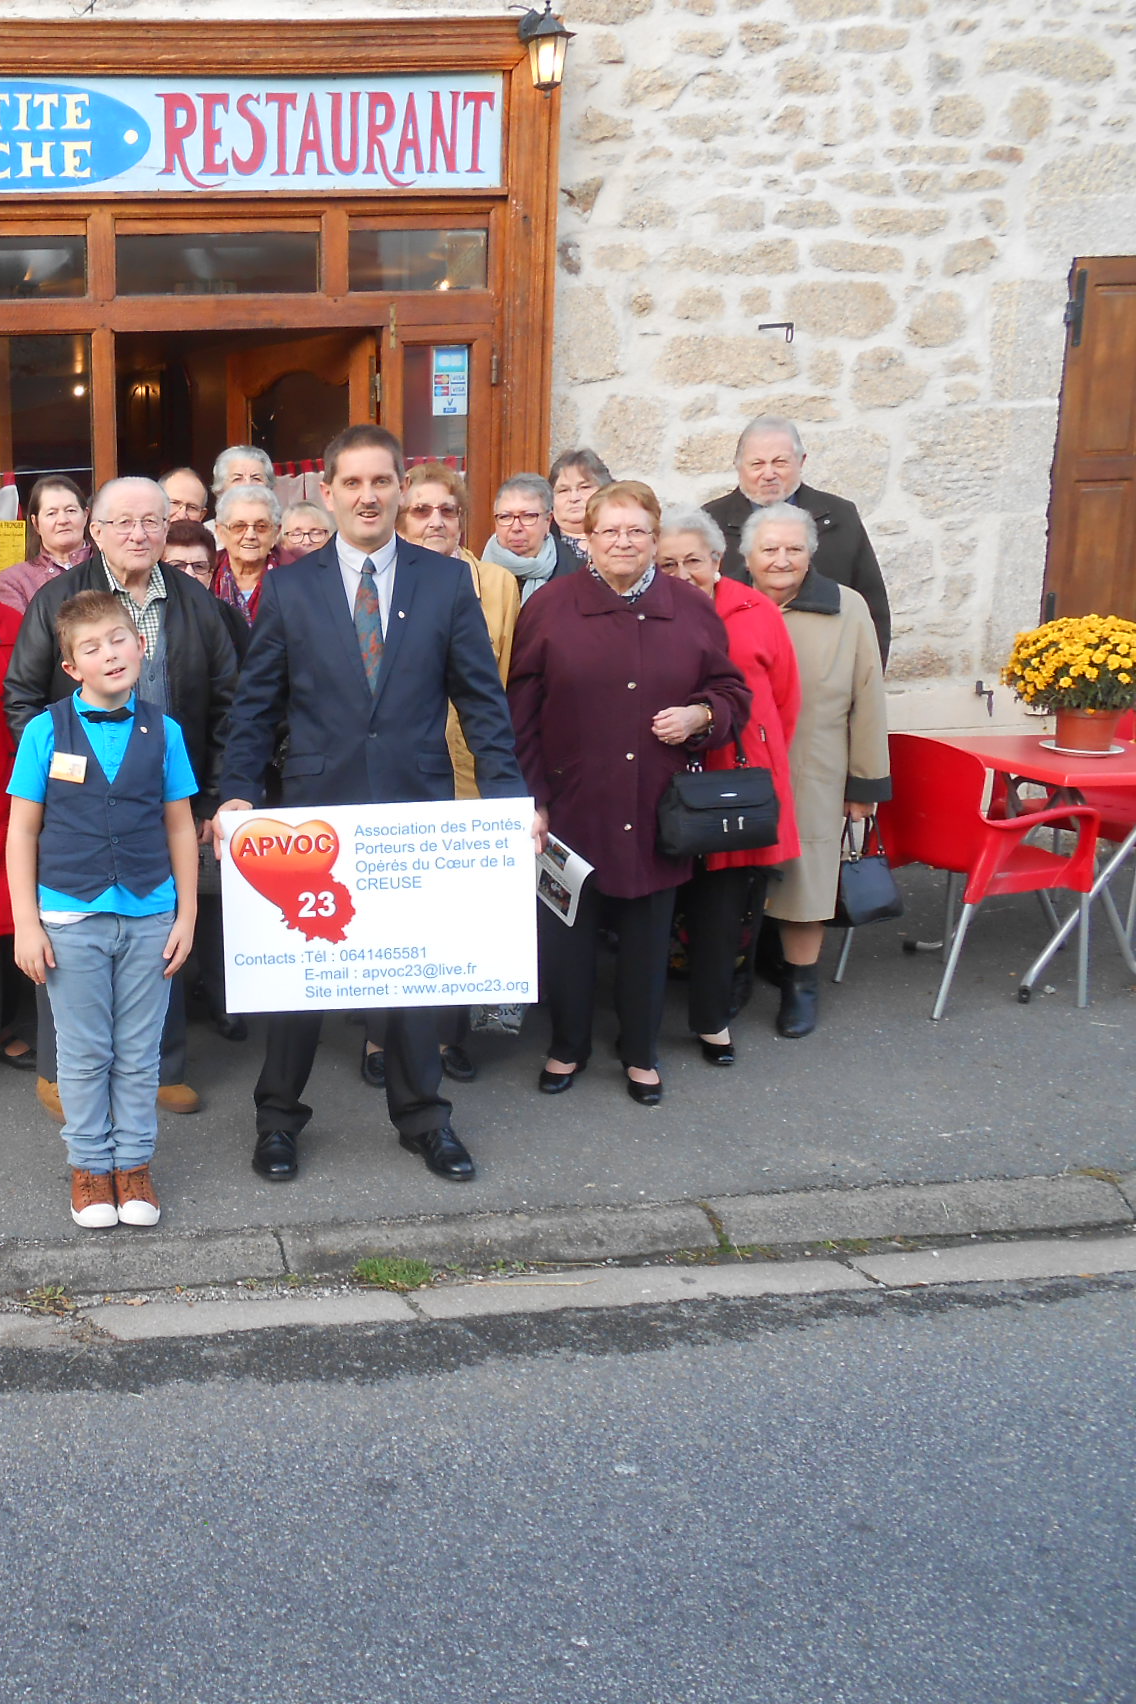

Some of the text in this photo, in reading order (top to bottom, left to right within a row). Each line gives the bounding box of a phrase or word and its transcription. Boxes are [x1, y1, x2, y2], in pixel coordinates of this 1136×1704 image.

[155, 90, 496, 189] RESTAURANT
[354, 818, 525, 837] Association des Pontés,
[239, 833, 335, 857] APVOC
[355, 837, 509, 855] Porteurs de Valves et
[355, 854, 515, 875] Opérés du Cœur de la
[356, 875, 422, 891] CREUSE
[297, 890, 337, 918] 23
[234, 953, 296, 966] Contacts
[339, 947, 427, 962] 0641465581
[305, 967, 349, 981] E-mail
[362, 962, 477, 981] apvoc23@live.fr
[305, 985, 332, 998] Site
[336, 984, 389, 998] internet
[402, 979, 529, 996] www.apvoc23.org
